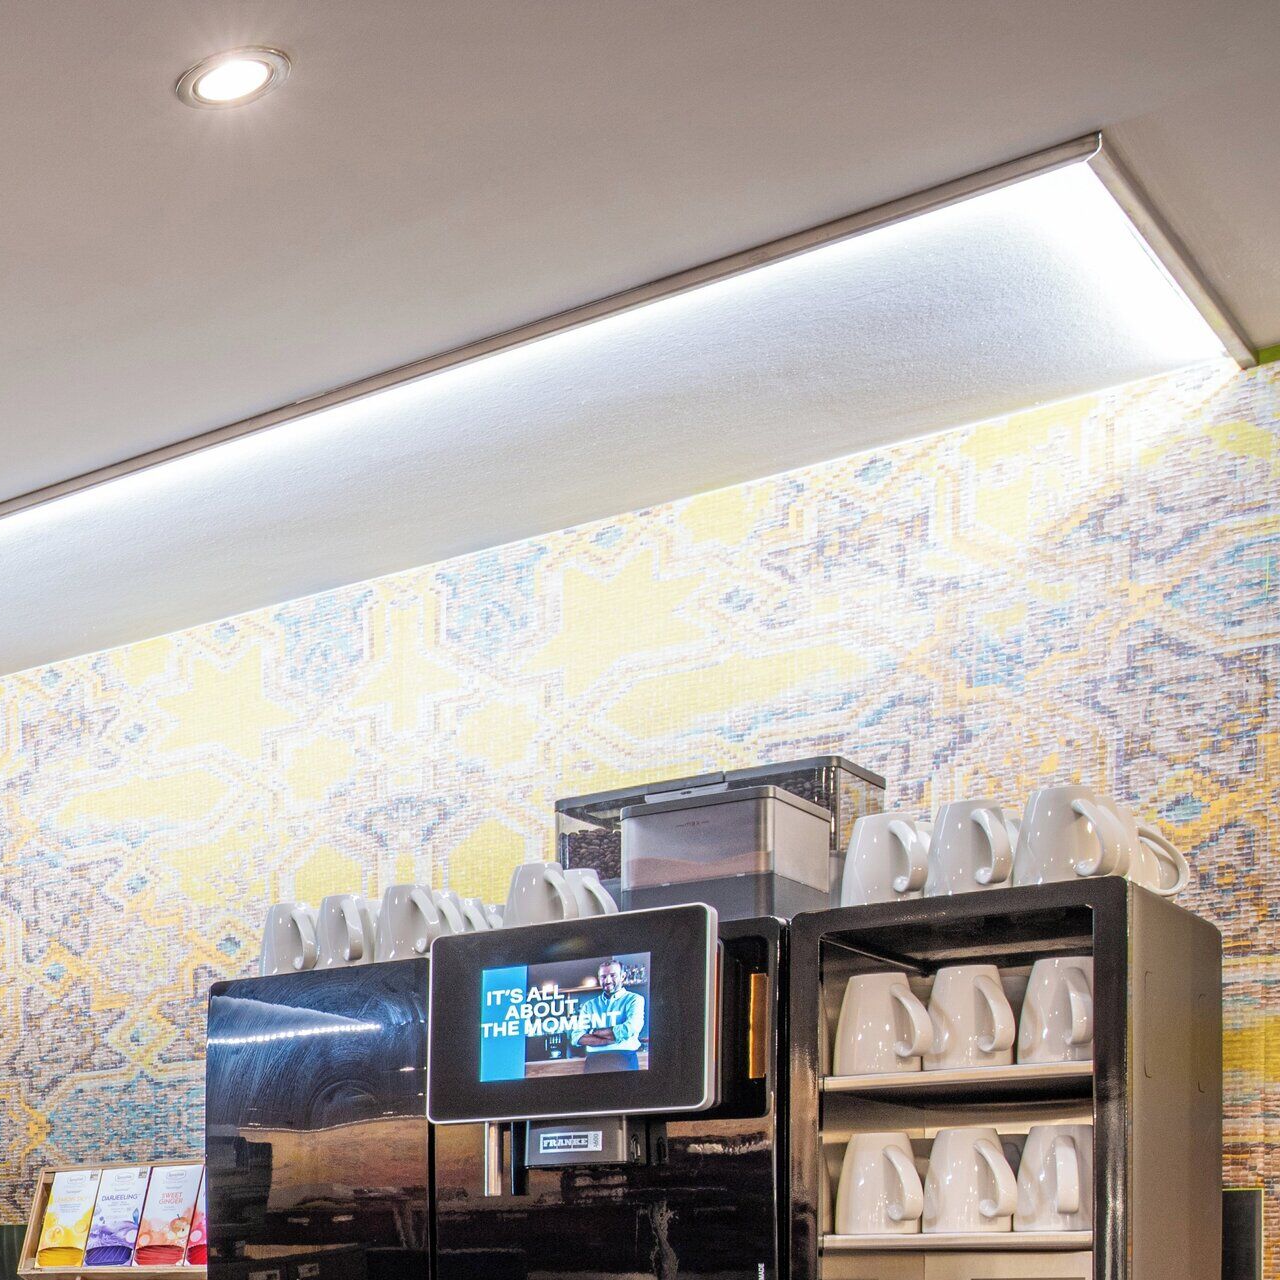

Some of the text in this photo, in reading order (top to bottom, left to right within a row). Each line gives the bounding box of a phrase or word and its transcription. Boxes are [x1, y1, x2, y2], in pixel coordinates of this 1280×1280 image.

[486, 984, 565, 1006] IT'S ALL
[505, 999, 579, 1021] ABOUT
[481, 1010, 621, 1038] THE MOMENT
[543, 1138, 588, 1148] FRANKE
[101, 1193, 139, 1202] DARJEELING
[161, 1191, 184, 1199] SWEET
[757, 1262, 765, 1280] MADE
